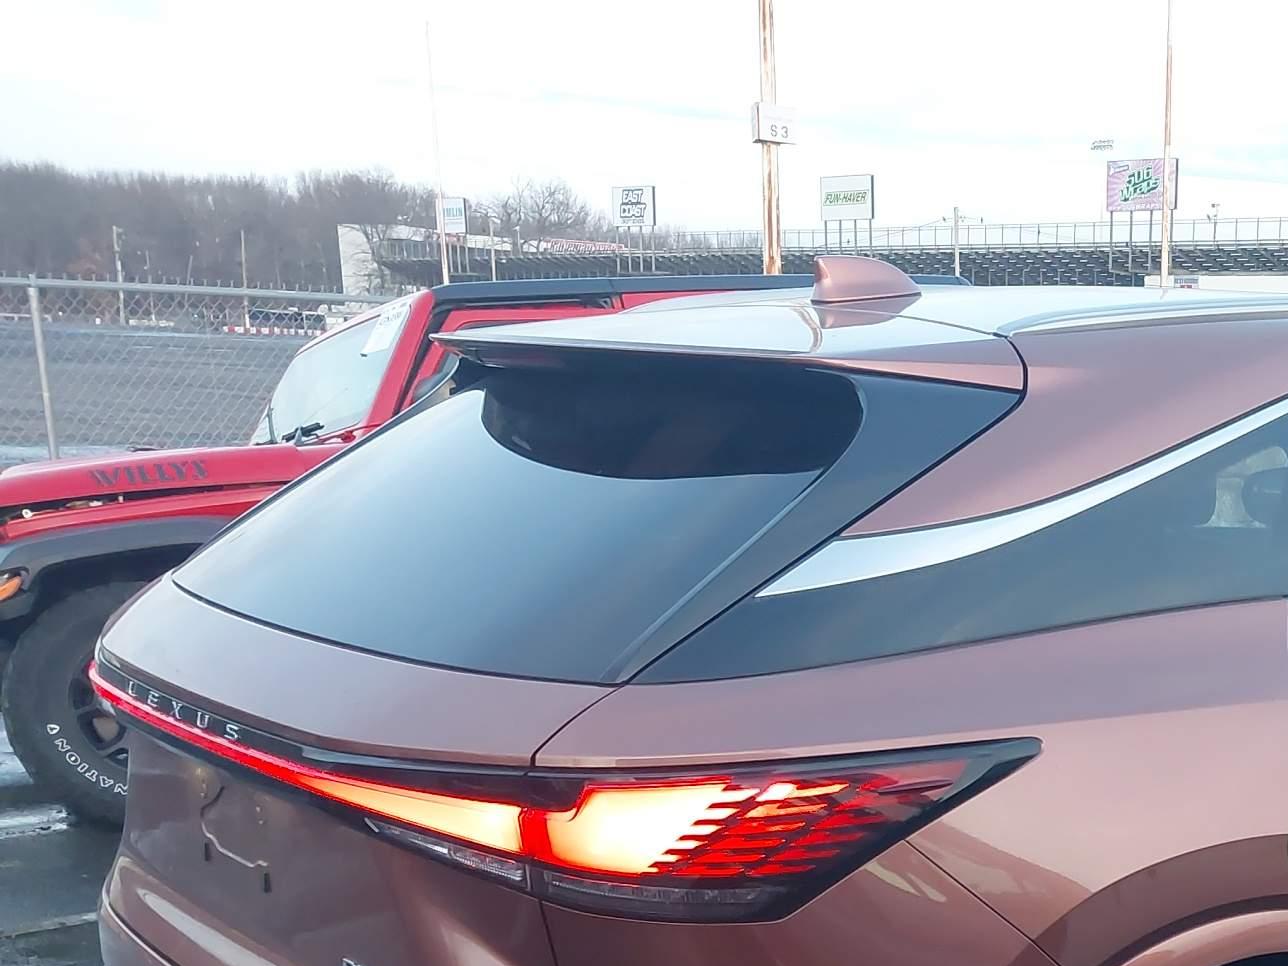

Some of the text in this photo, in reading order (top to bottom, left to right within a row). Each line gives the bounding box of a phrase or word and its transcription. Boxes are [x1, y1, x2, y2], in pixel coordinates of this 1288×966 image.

[622, 189, 644, 204] EAST
[824, 191, 868, 205] FUN-HAVER
[620, 203, 647, 219] COAST
[91, 460, 208, 487] WILLYS
[127, 680, 240, 740] LEXUS
